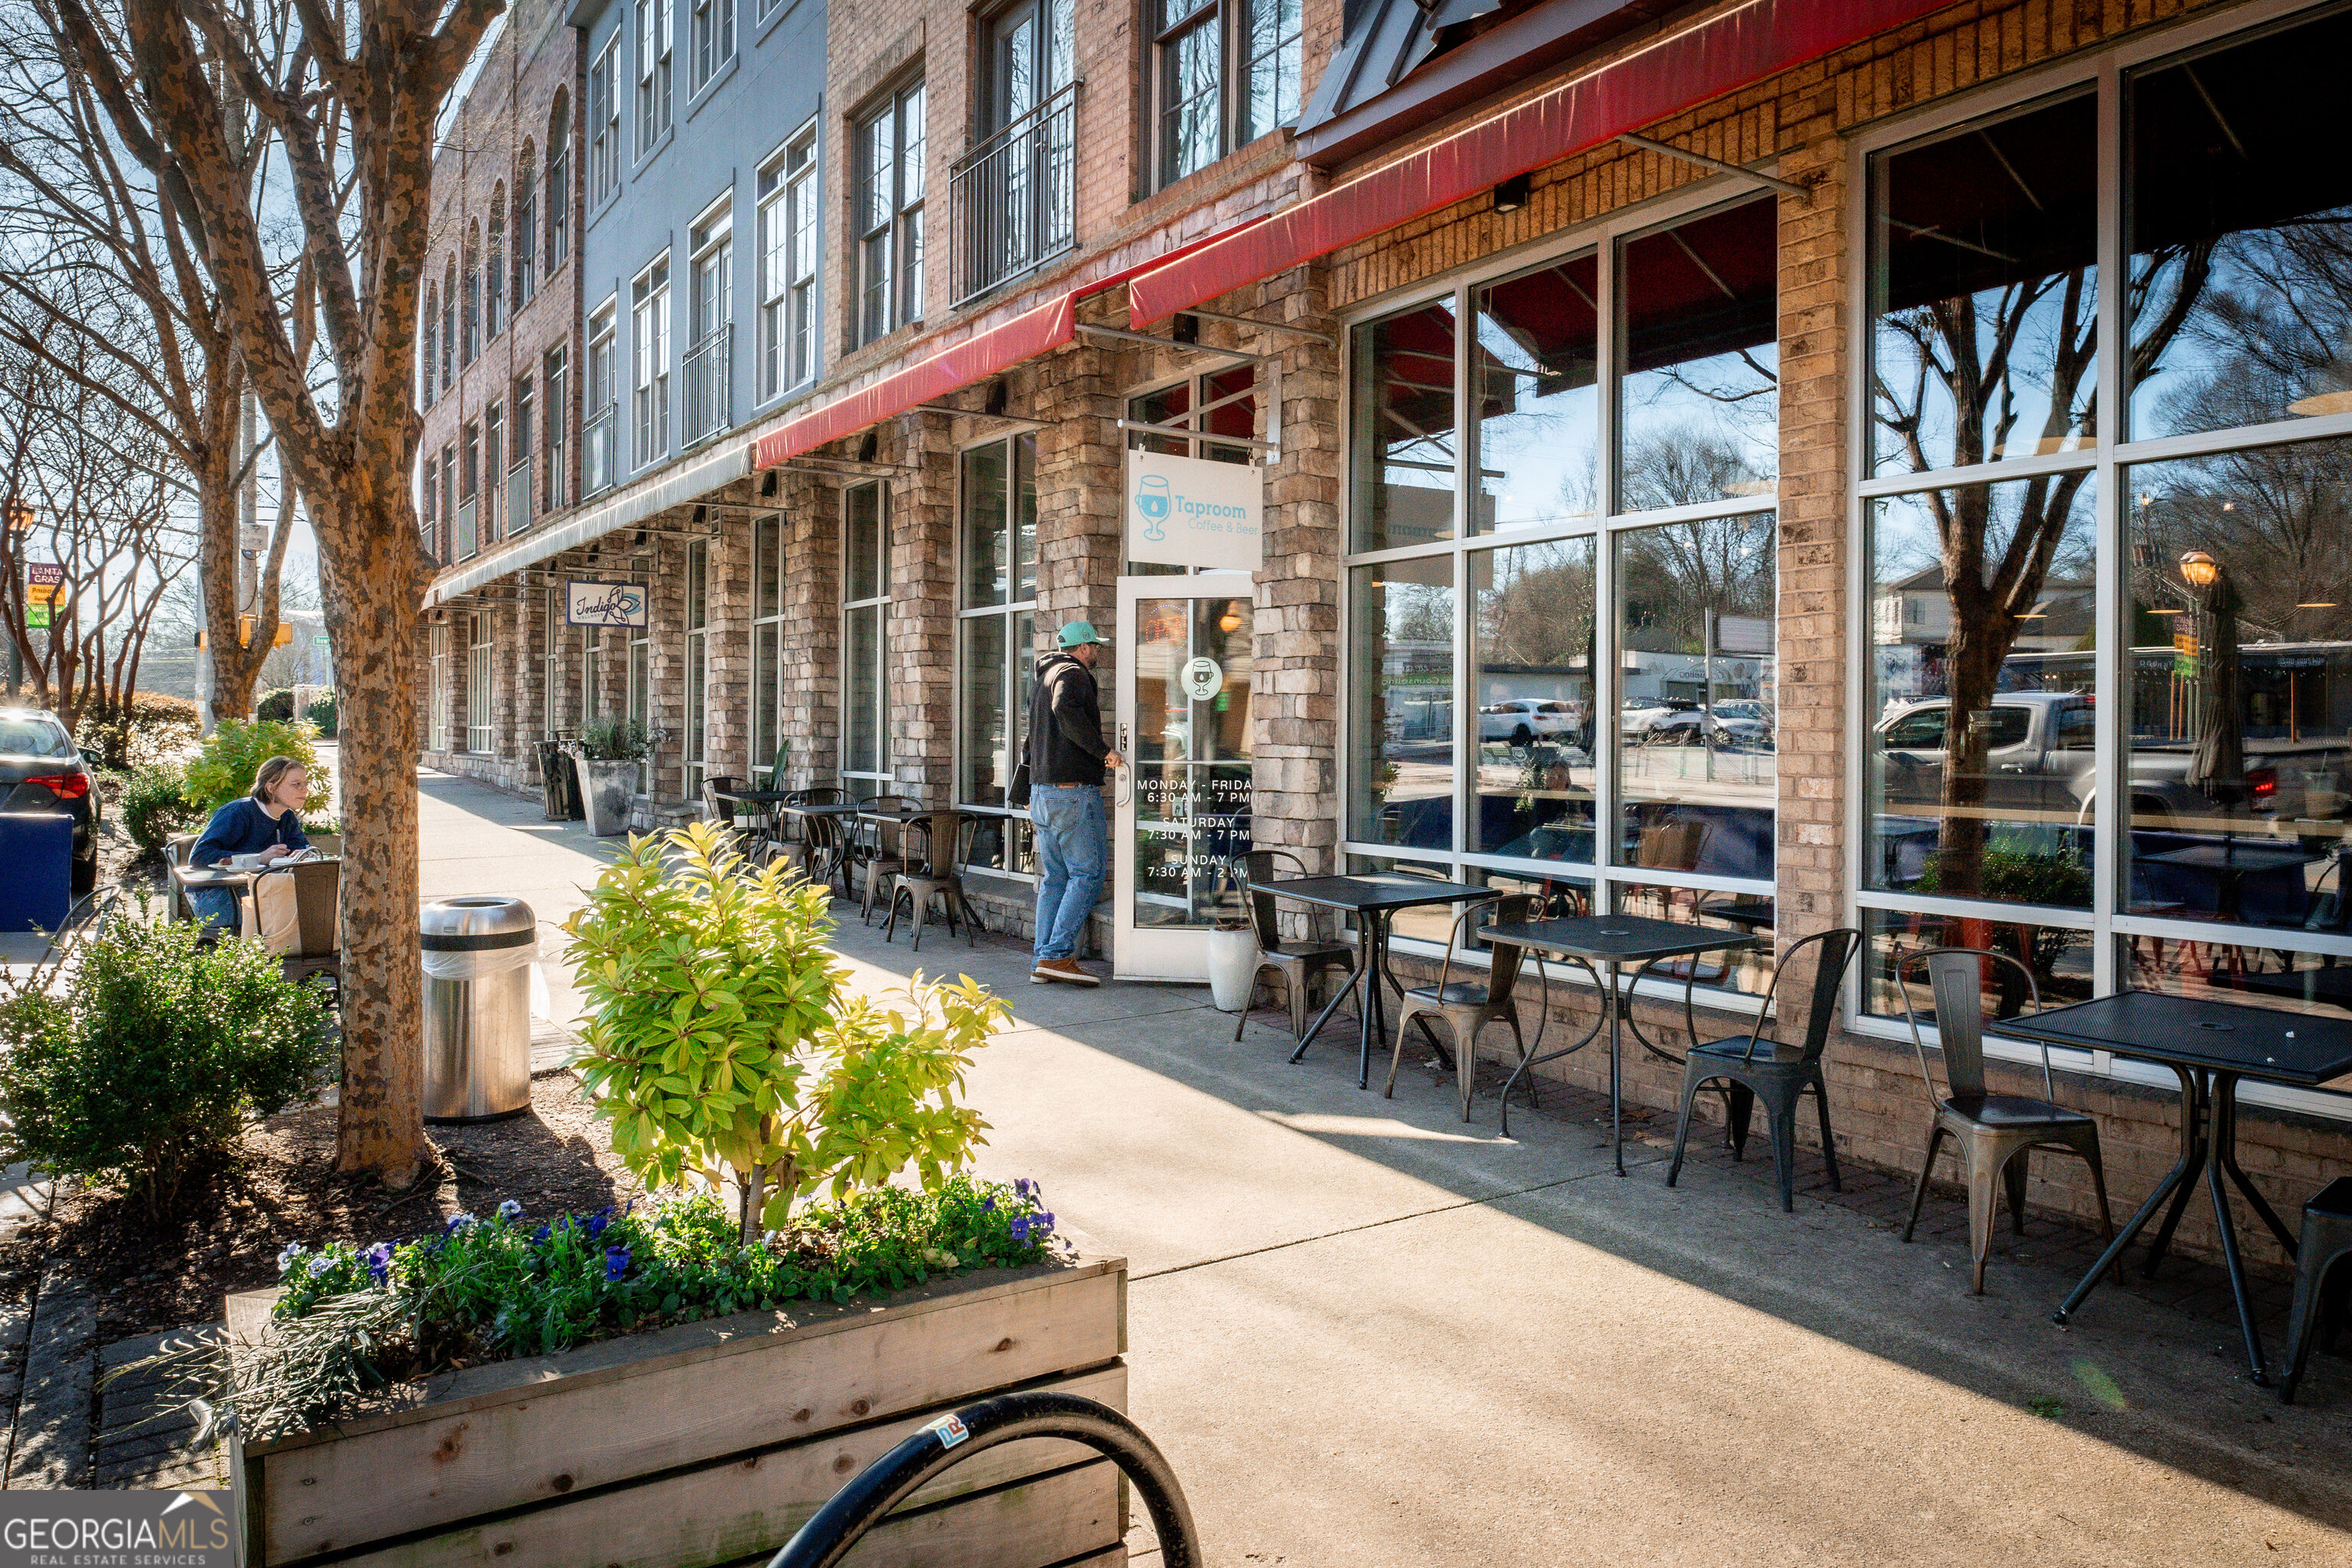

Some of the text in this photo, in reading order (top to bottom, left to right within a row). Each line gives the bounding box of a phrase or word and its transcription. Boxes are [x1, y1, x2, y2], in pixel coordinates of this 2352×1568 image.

[1175, 495, 1246, 519] Taproom
[1188, 518, 1258, 535] Coffee & Beer
[34, 575, 60, 583] GRAS
[577, 596, 616, 622] Indigo
[1145, 612, 1187, 644] OPEN
[1137, 780, 1197, 790] MONDAY
[1212, 780, 1252, 790] FRIDA
[1147, 792, 1176, 802] 6:30
[1181, 792, 1201, 802] AM
[1217, 792, 1224, 802] 7
[1230, 792, 1250, 802] PM
[1163, 817, 1235, 828] SATURDAY
[1148, 830, 1176, 840] 7:30
[1181, 830, 1201, 840] AM
[1217, 830, 1224, 840] 7
[1230, 830, 1250, 840] PM
[1171, 854, 1227, 864] SUNDAY
[1148, 867, 1176, 877] 7:30
[1181, 867, 1201, 877] AM
[1217, 867, 1224, 877] 2
